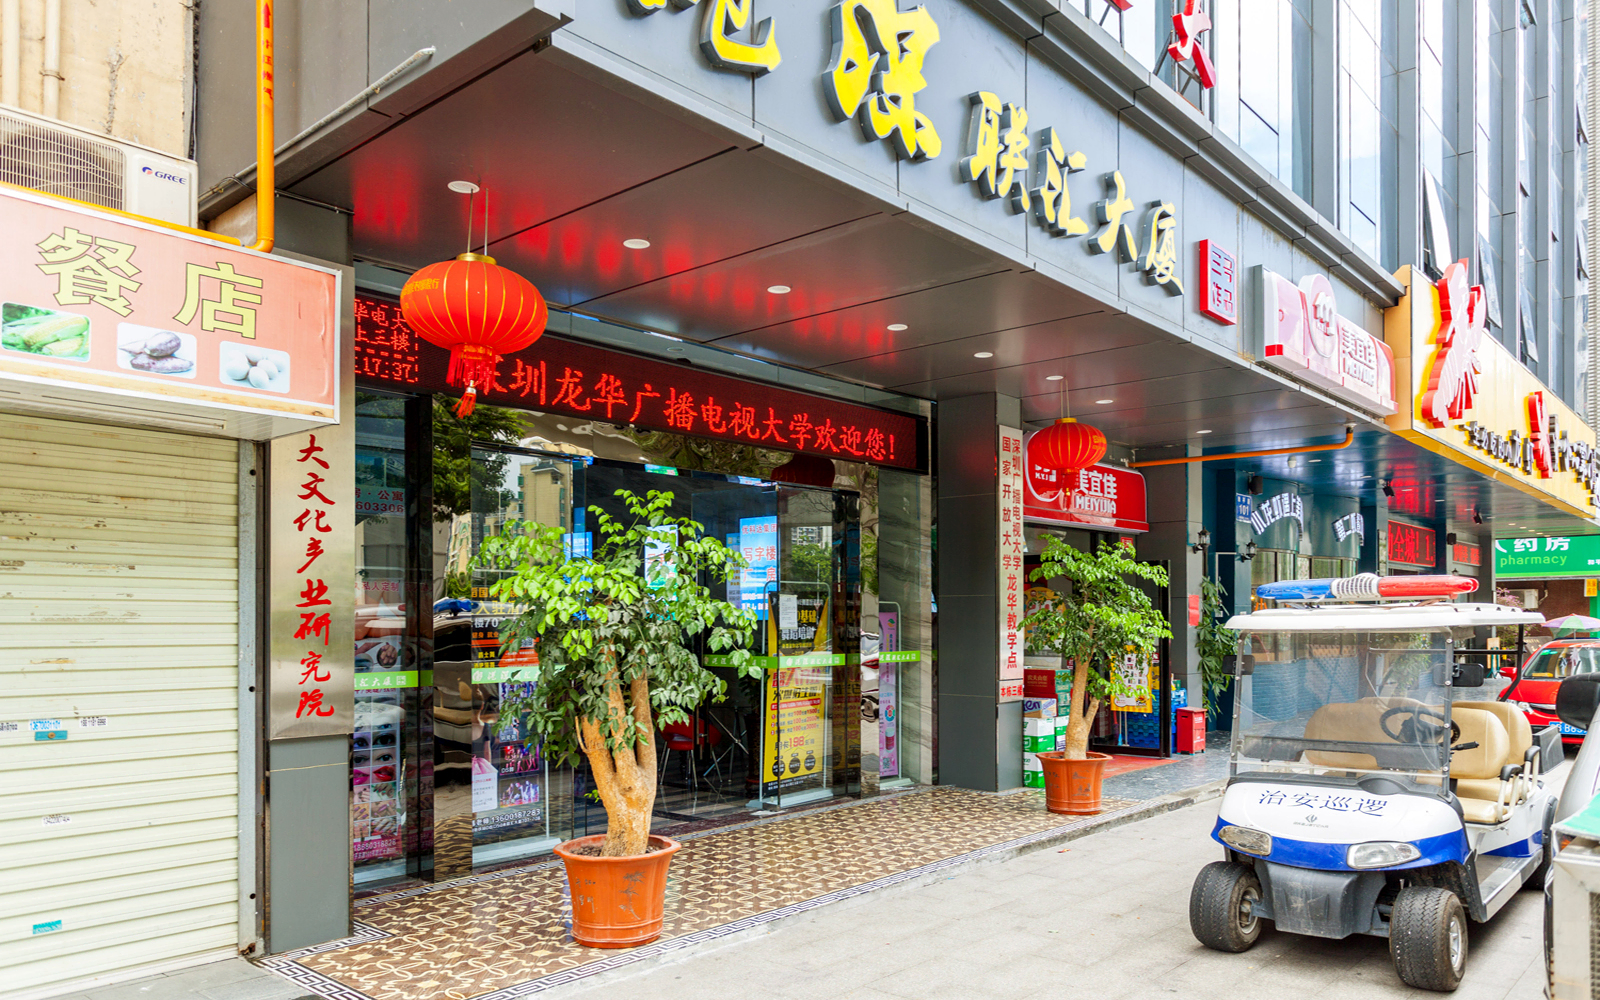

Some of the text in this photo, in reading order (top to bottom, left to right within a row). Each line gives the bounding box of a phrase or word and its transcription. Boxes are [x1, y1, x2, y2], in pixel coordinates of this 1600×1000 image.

[155, 170, 187, 185] GREE
[36, 226, 263, 339] 餐店
[1076, 468, 1117, 499] 美宜佳
[1002, 436, 1011, 570] 国家开放大学
[1012, 438, 1021, 571] 深圳广播电视大学
[1239, 504, 1249, 516] 101
[743, 546, 777, 561] 写字楼
[1500, 555, 1567, 568] pharmacy
[293, 434, 335, 719] 大文化产业研究院
[1006, 573, 1018, 669] 龙华教学点
[1001, 684, 1022, 697] 本栋三楼
[1259, 790, 1388, 817] 治安巡逻
